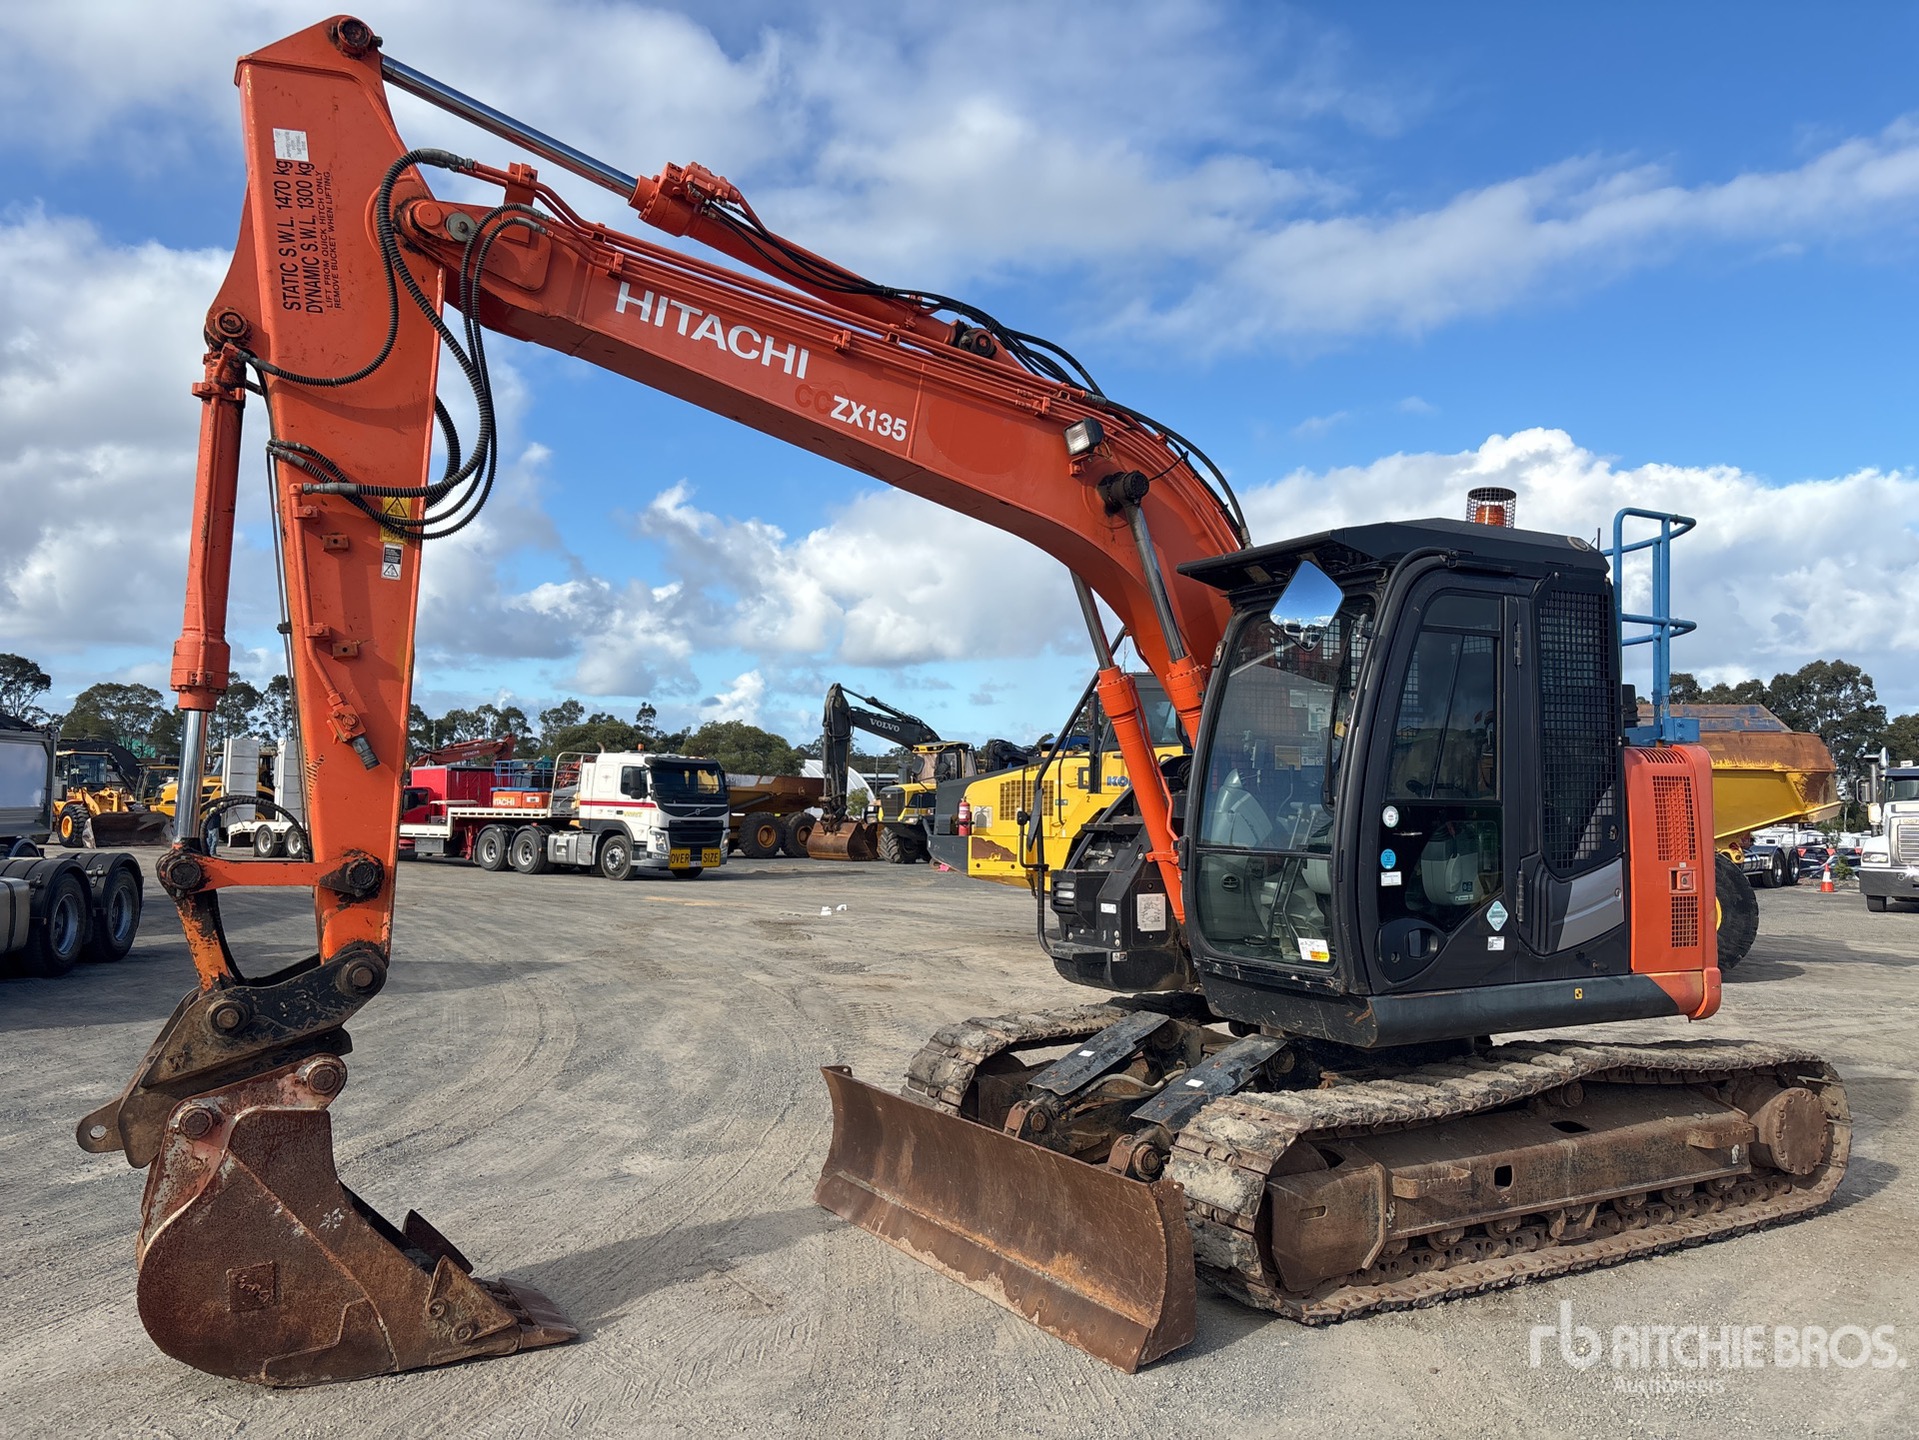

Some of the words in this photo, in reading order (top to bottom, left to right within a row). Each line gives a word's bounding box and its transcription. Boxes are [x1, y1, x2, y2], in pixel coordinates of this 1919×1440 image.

[272, 159, 293, 175] kg
[295, 161, 314, 176] kg
[274, 180, 293, 210] 1470
[296, 180, 314, 209] 1300
[315, 170, 323, 194] ONLY
[324, 171, 332, 204] LIFTING
[317, 198, 326, 225] HITCH
[327, 207, 335, 232] WHEN
[277, 216, 297, 257] S.W.L.
[320, 228, 329, 256] QUICK
[329, 236, 338, 270] BUCKET
[279, 262, 302, 311] STATIC
[301, 257, 323, 313] DYNAMIC
[323, 260, 331, 285] FROM
[325, 289, 333, 308] LIFT
[333, 273, 341, 309] REMOVE
[615, 281, 810, 379] HITACHI
[830, 394, 908, 442] ZX135
[868, 717, 901, 733] VOLVO
[670, 853, 690, 864] OVER
[703, 852, 719, 863] SIZE
